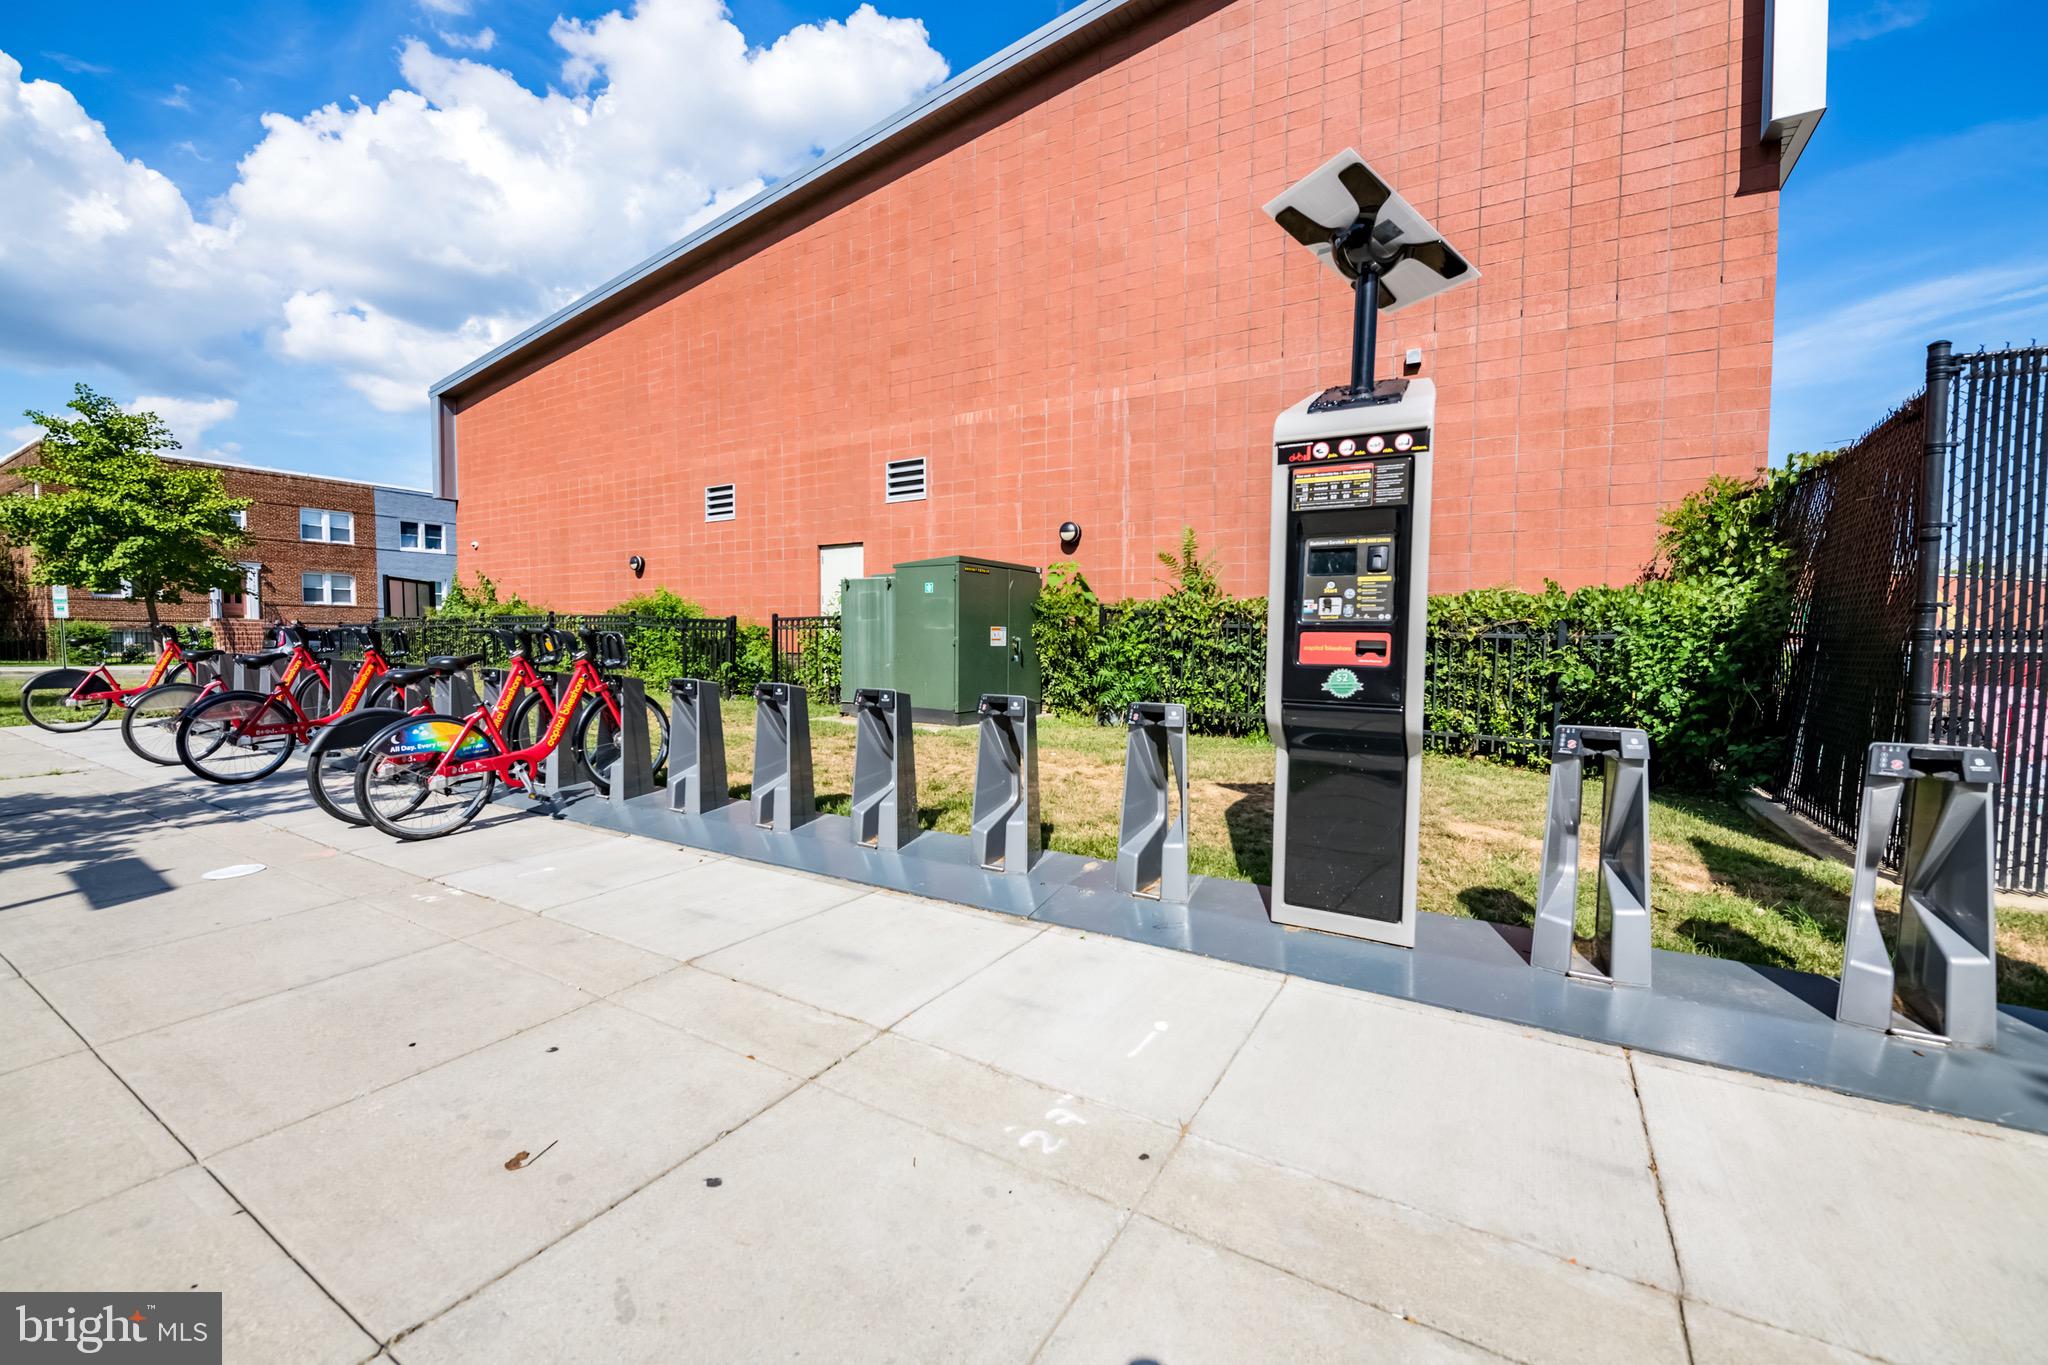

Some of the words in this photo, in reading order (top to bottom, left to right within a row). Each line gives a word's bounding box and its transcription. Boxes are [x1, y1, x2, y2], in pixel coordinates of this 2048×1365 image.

[498, 676, 522, 710] bikeshare
[547, 716, 566, 747] capital
[560, 677, 585, 715] bikeshare
